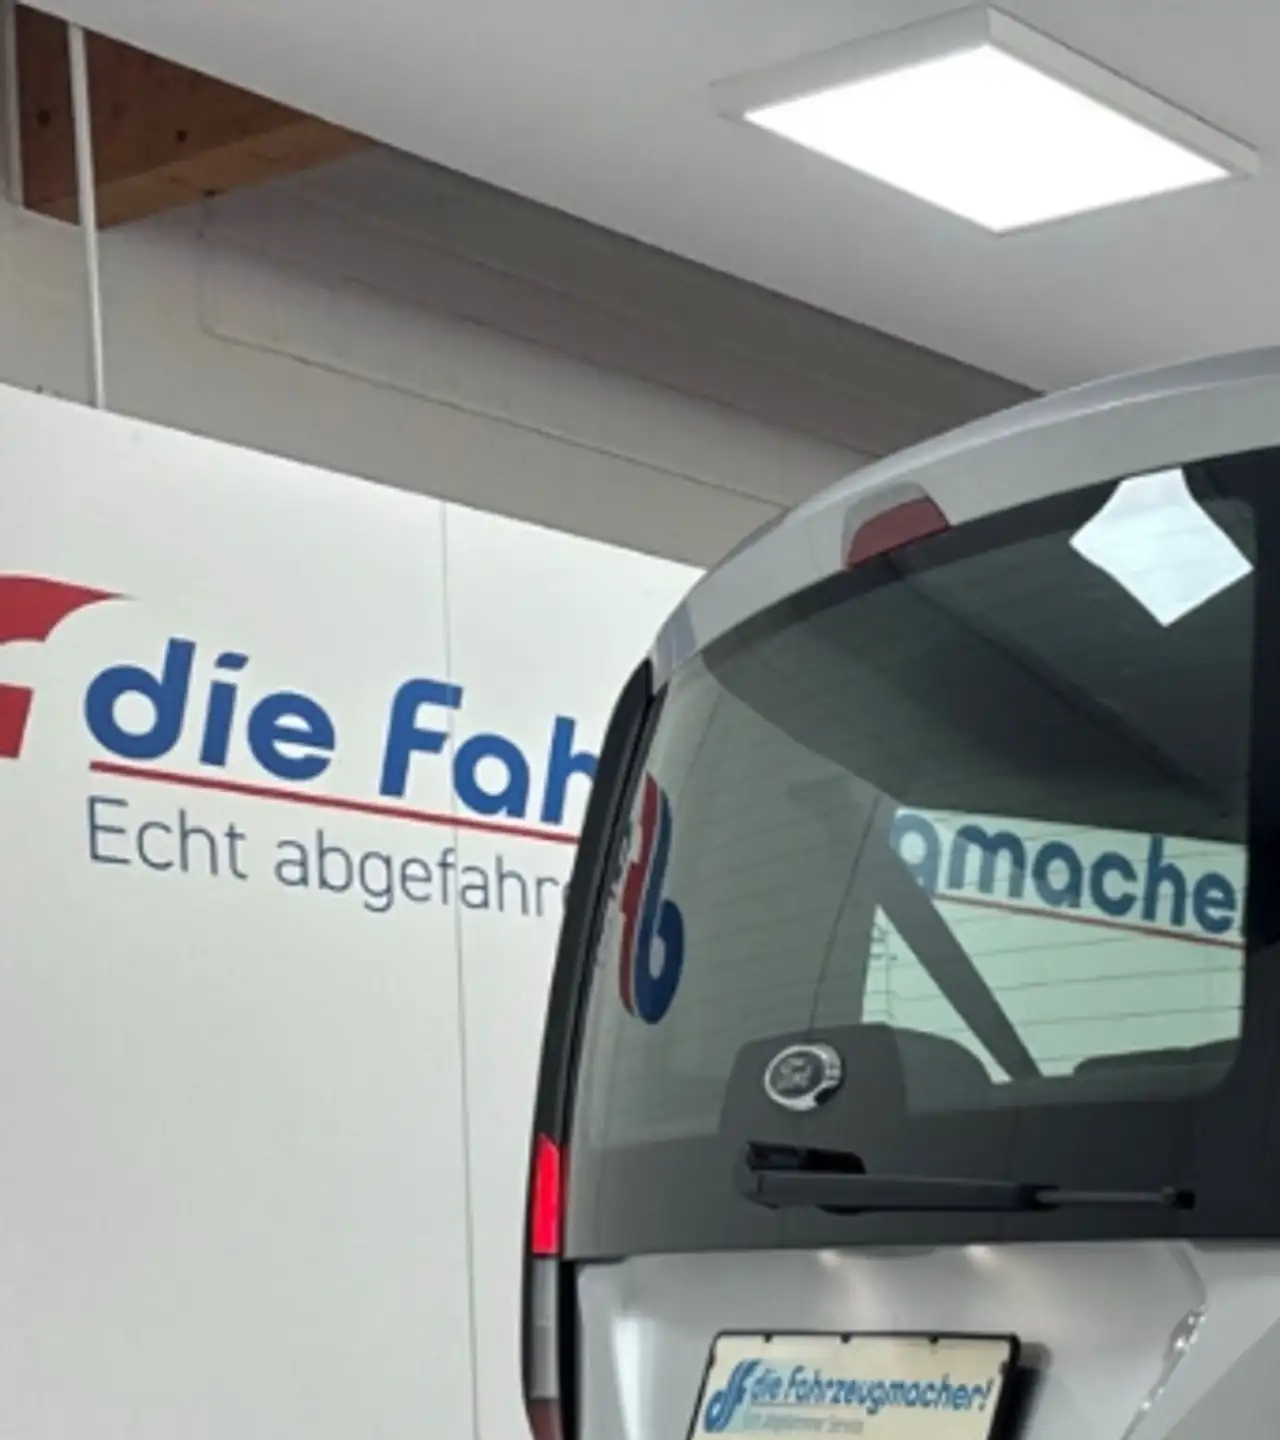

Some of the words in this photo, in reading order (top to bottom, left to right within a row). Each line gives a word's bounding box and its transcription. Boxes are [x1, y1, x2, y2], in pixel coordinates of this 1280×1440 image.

[84, 637, 336, 781] die
[87, 796, 248, 880] Echt
[274, 829, 570, 917] abgefahr
